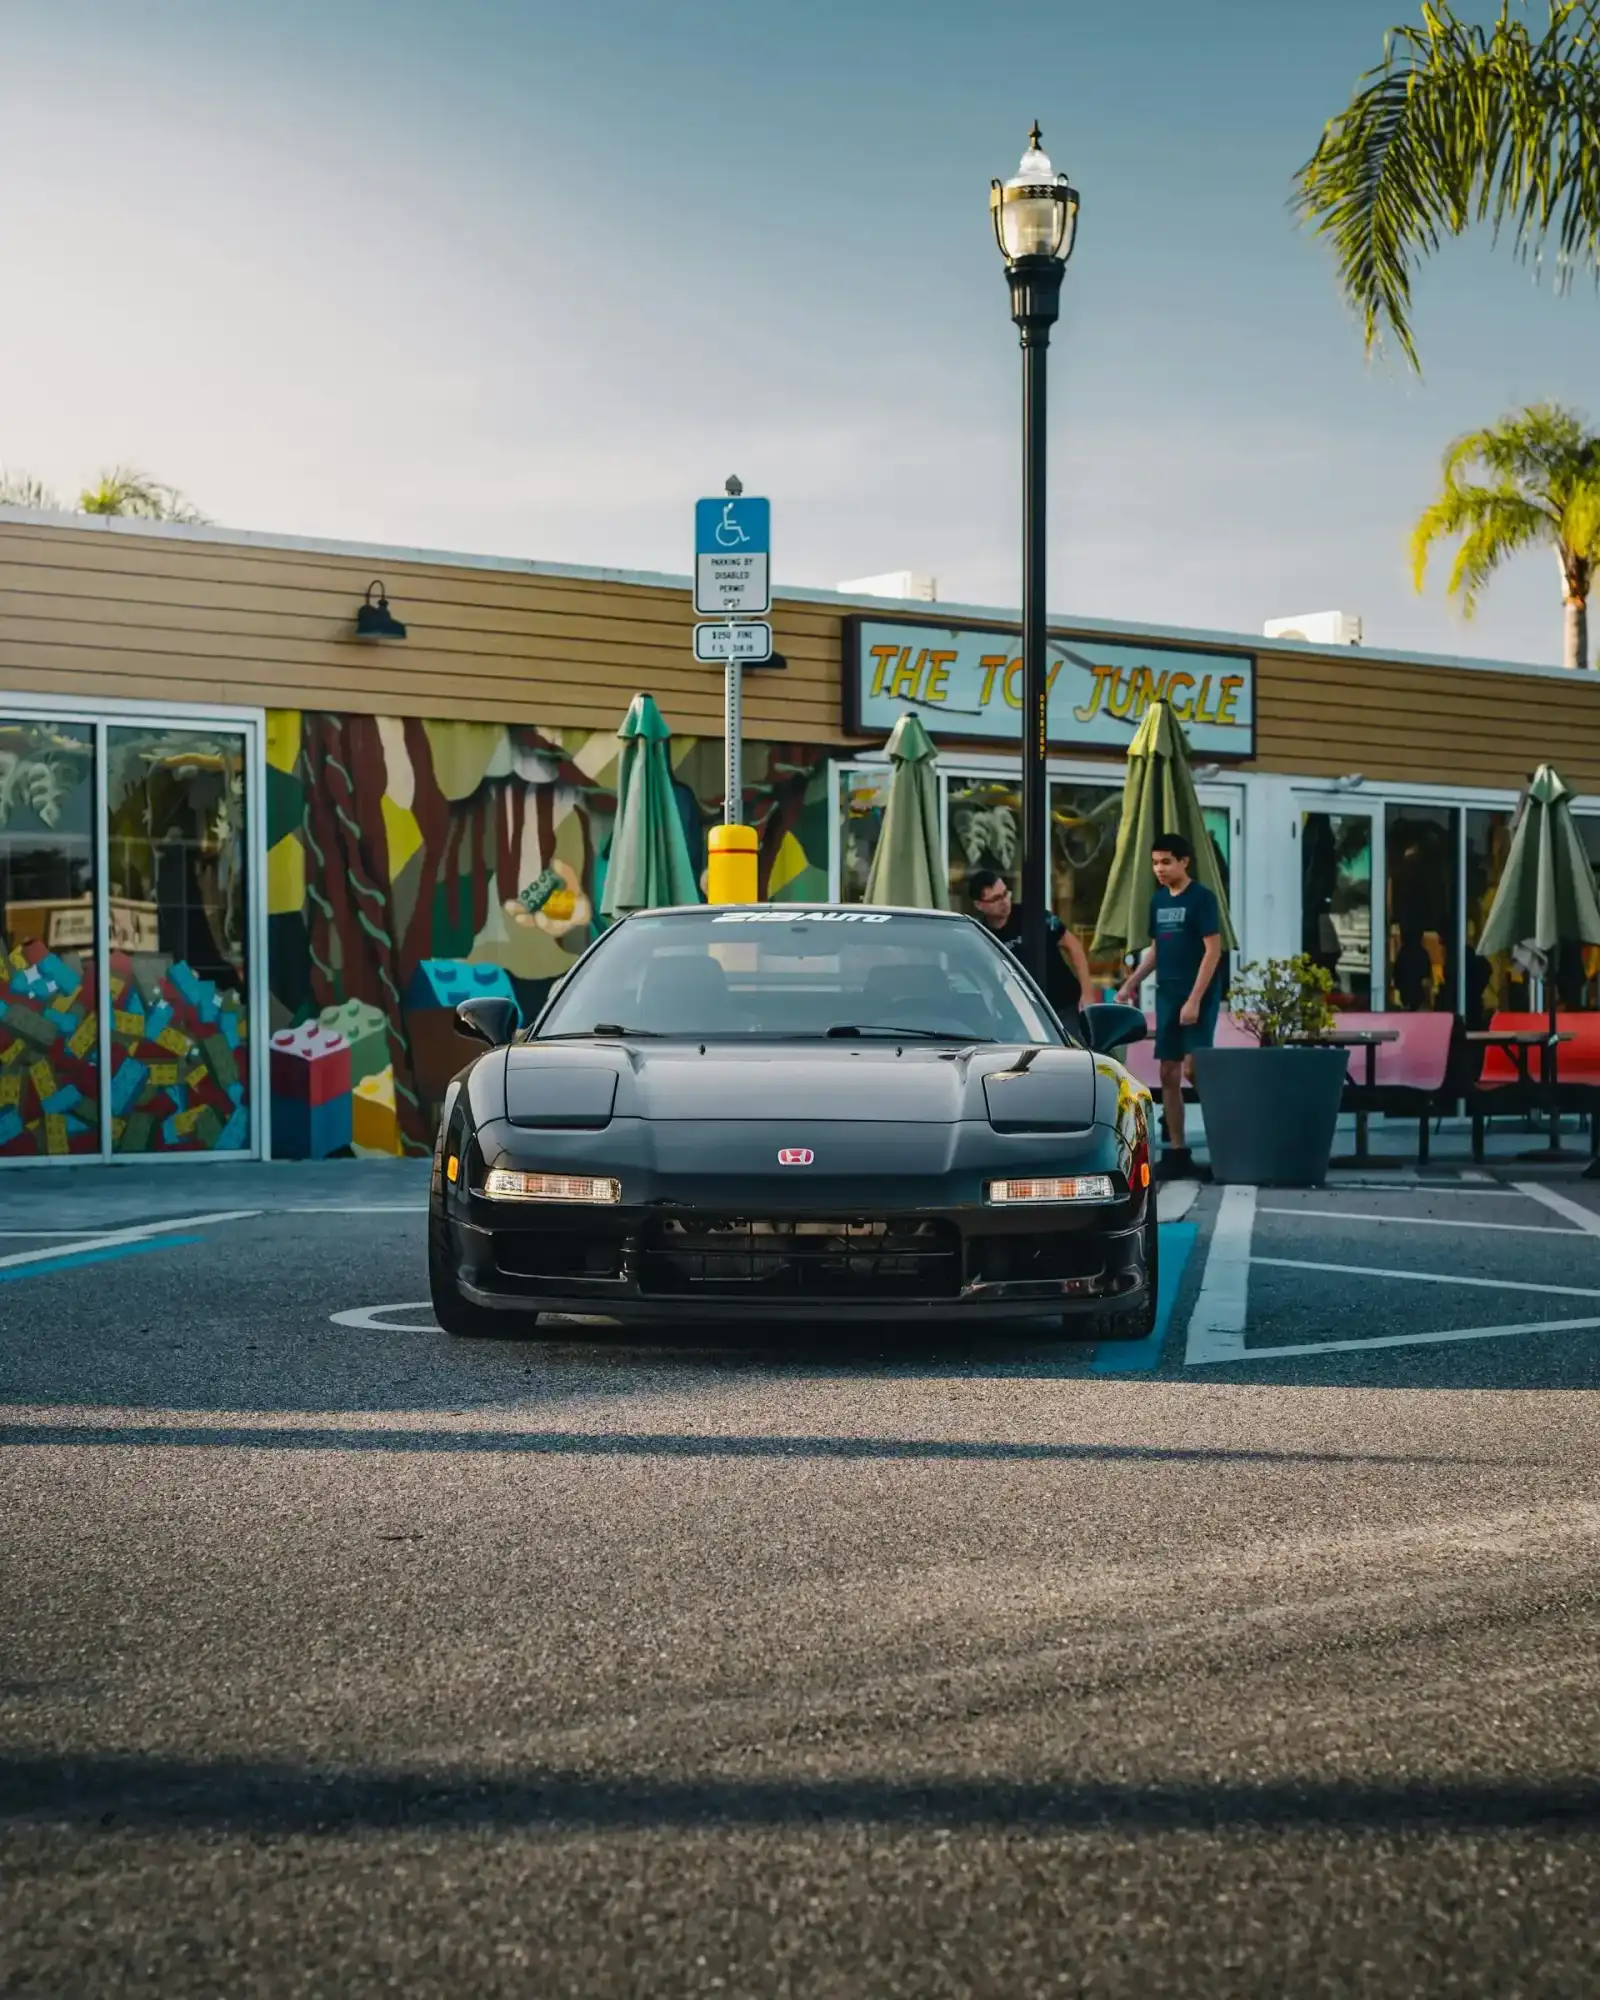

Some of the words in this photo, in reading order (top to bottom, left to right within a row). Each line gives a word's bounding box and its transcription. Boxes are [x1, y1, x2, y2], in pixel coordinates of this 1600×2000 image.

[711, 558, 741, 566] PARKING
[744, 558, 753, 566] BY
[715, 570, 750, 580] DISABLED
[719, 584, 745, 593] PERMIT
[712, 631, 731, 640] $250
[737, 630, 753, 639] FINE
[869, 644, 958, 702] THE
[1073, 665, 1244, 724] JUNGLE
